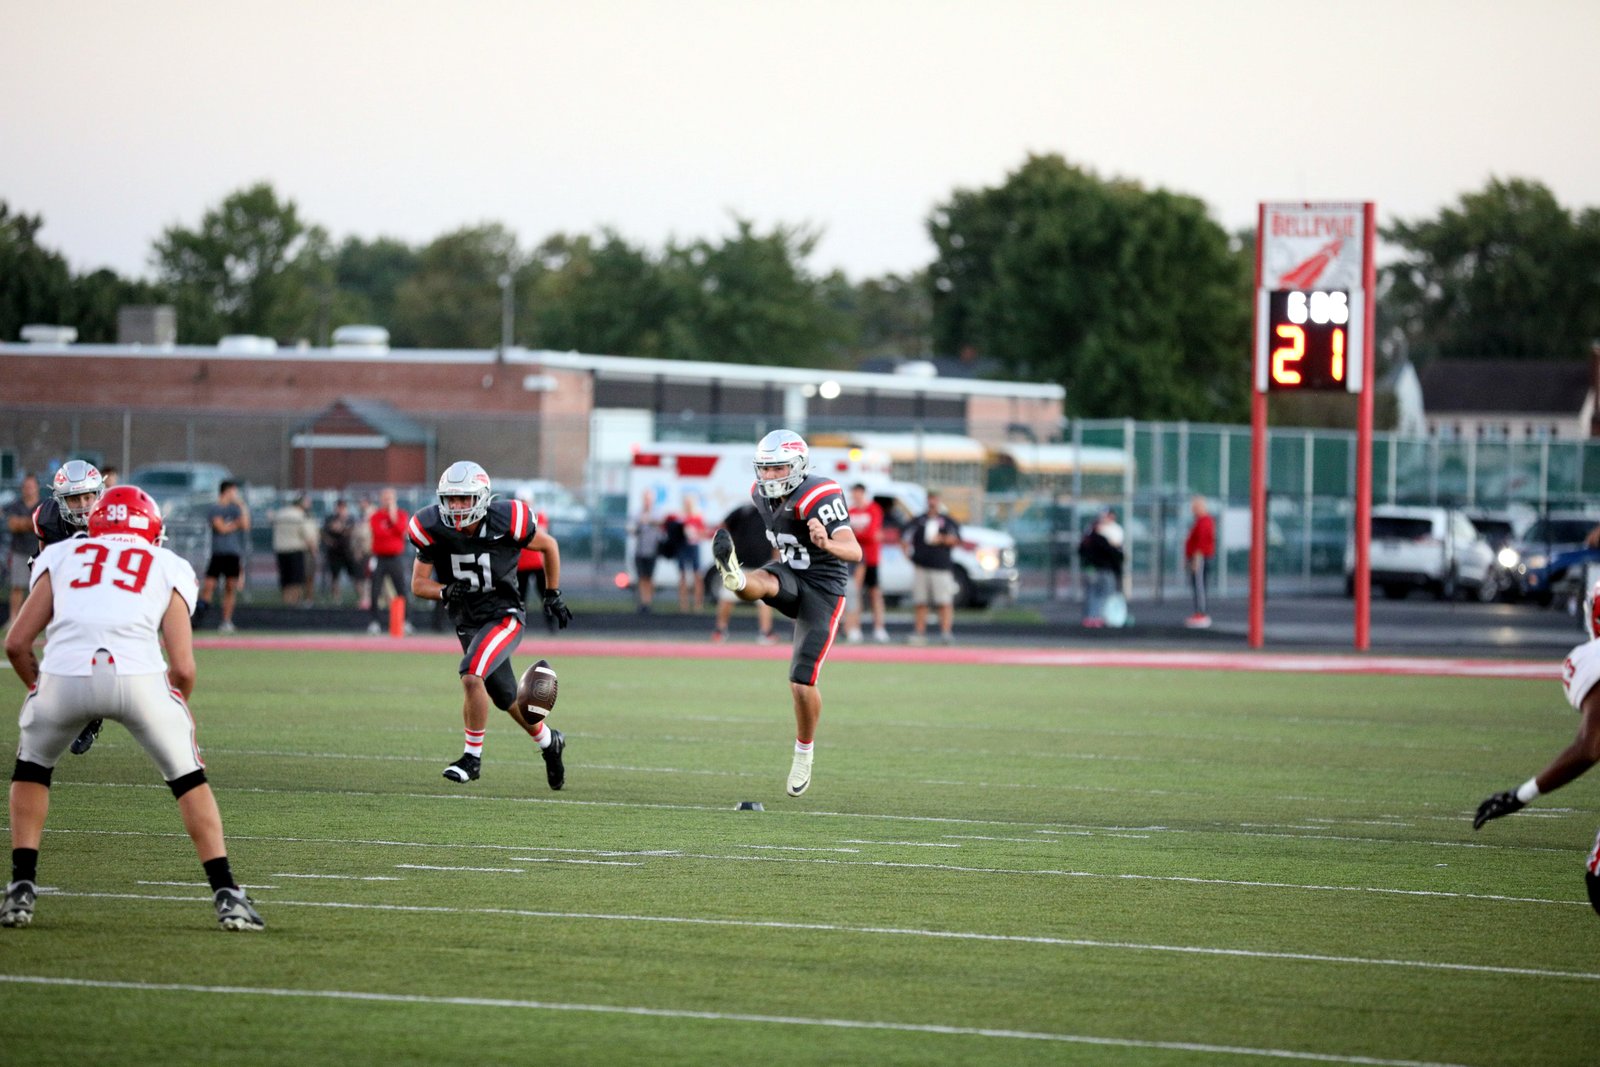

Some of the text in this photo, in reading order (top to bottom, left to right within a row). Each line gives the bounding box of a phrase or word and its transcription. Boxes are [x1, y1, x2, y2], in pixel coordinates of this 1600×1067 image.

[106, 503, 128, 522] 39
[818, 499, 848, 526] 80
[70, 543, 154, 594] 39
[450, 552, 496, 593] 51
